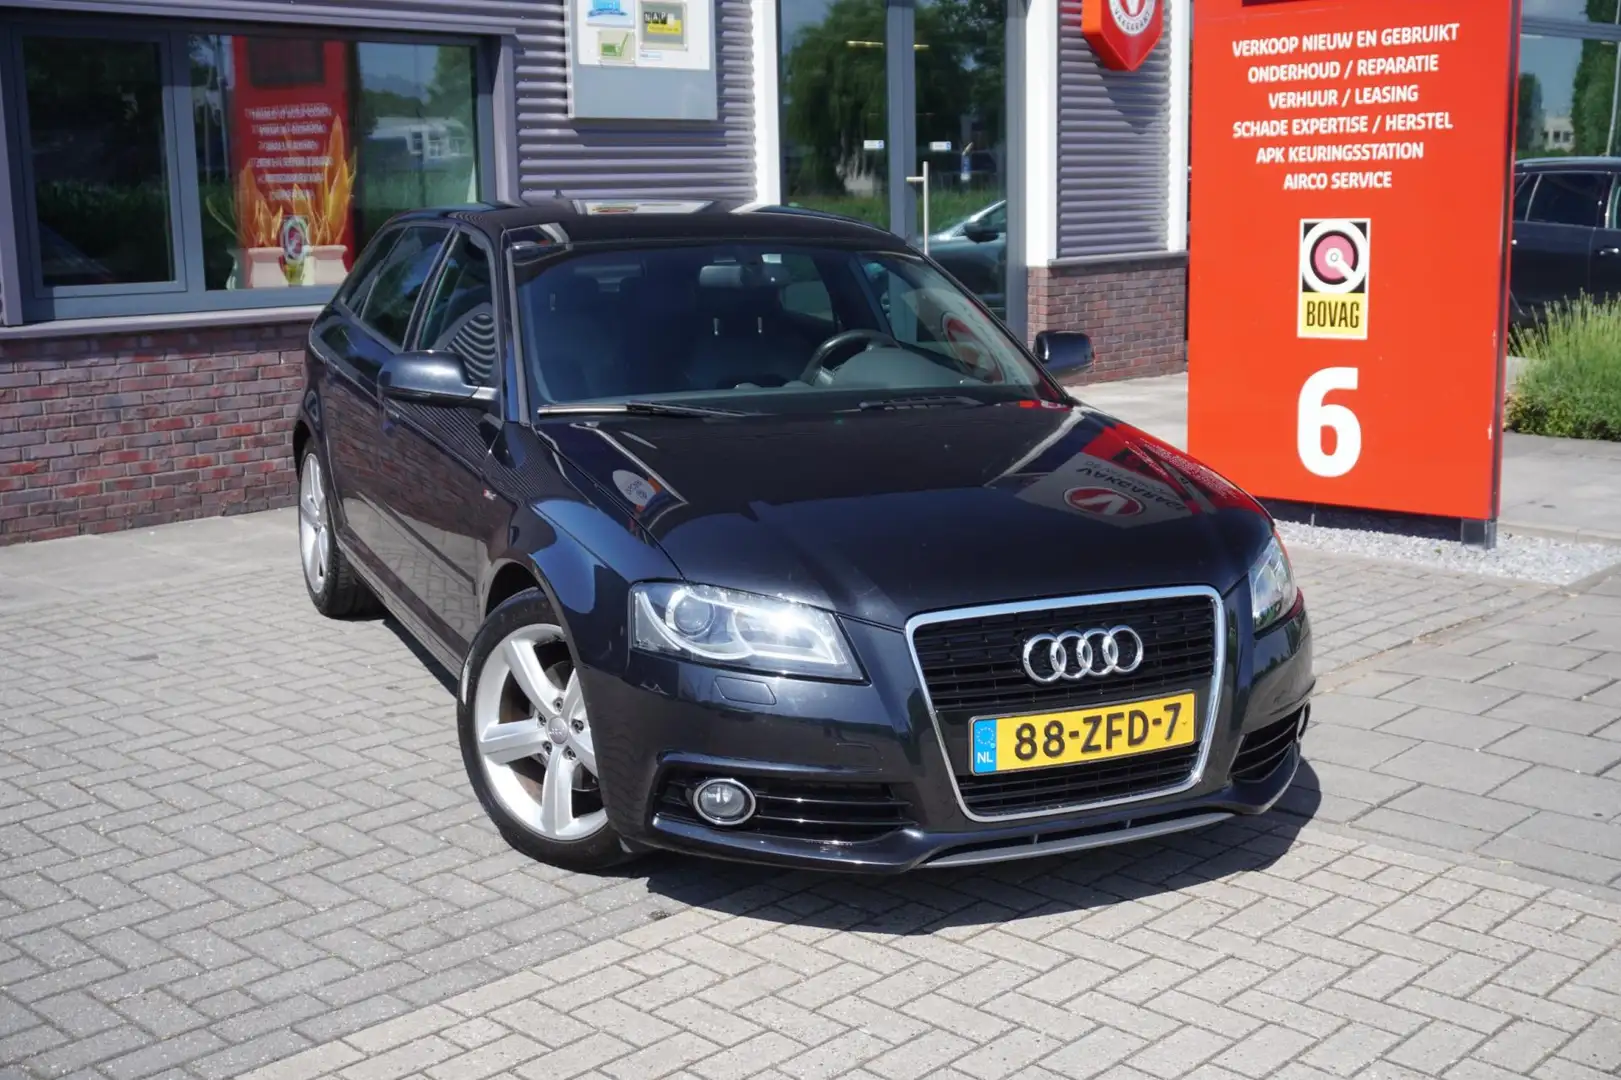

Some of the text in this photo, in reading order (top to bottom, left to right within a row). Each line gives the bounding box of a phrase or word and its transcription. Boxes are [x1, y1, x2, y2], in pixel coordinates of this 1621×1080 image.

[1231, 22, 1460, 57] VERKOOP NIEUW EN GEBRUIKT
[1247, 61, 1341, 83] ONDERHOUD
[1357, 54, 1439, 76] REPARATIE
[1268, 89, 1339, 109] VERHUUR
[1355, 85, 1419, 104] LEASING
[1232, 120, 1288, 138] SCHADE
[1292, 116, 1368, 135] EXPERTISE
[1385, 112, 1454, 131] HERSTEL
[1256, 142, 1424, 164] APK KEURINGSSTATION
[1283, 171, 1393, 190] AIRCO SERVICE
[1306, 300, 1360, 329] BOVAG
[1297, 366, 1362, 478] 6
[1014, 702, 1182, 761] 88-ZFD-7
[977, 752, 994, 764] NL
